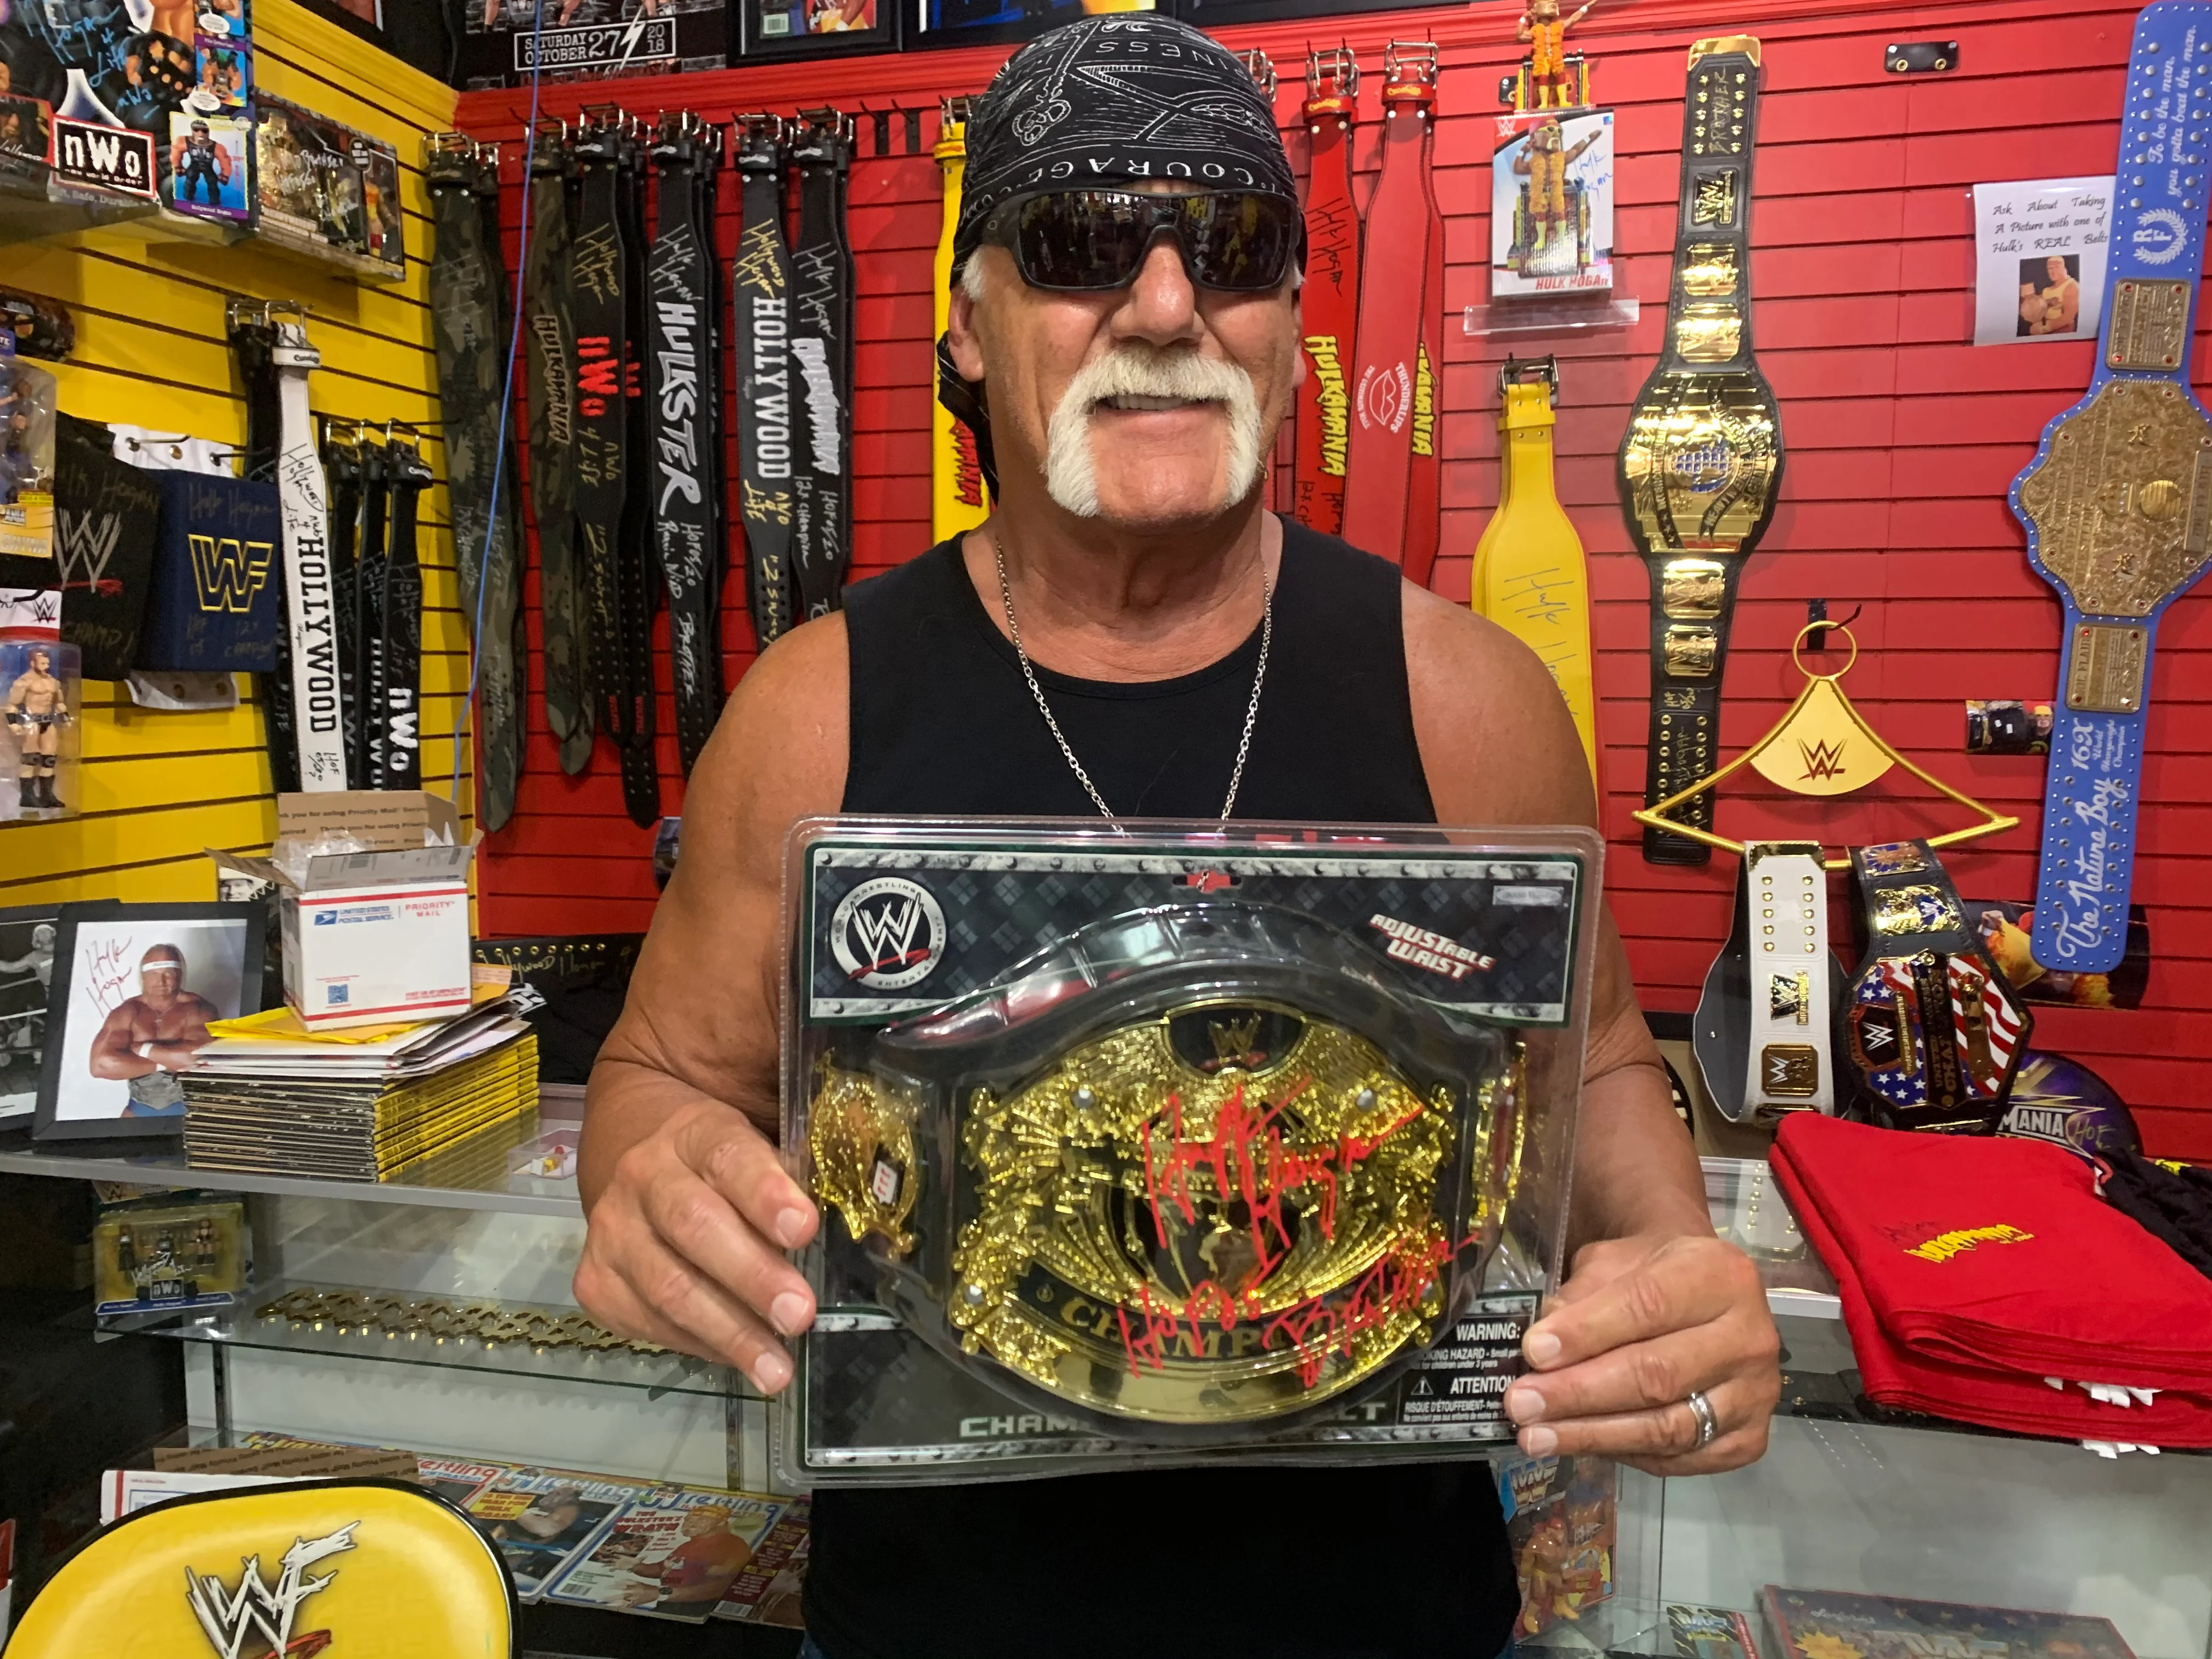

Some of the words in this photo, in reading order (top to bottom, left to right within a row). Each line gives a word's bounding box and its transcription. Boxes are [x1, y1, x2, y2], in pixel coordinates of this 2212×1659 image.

[588, 30, 621, 58] 27
[647, 24, 665, 38] 20
[648, 38, 665, 53] 18
[2174, 66, 2191, 89] the
[2154, 95, 2170, 119] the
[2171, 92, 2188, 124] beat
[2152, 122, 2167, 140] be
[2170, 127, 2187, 165] gotta
[64, 131, 141, 177] nWo
[2147, 143, 2165, 164] To
[2168, 168, 2183, 198] you
[1993, 202, 2013, 215] Ask
[2027, 199, 2058, 212] About
[2072, 194, 2106, 210] Taking
[1995, 223, 2005, 234] A
[2010, 221, 2044, 233] Picture
[2048, 215, 2069, 228] with
[2074, 217, 2090, 226] one
[2095, 212, 2107, 226] of
[1993, 239, 2023, 253] Hulk's
[2034, 236, 2071, 250] REAL
[2084, 231, 2109, 245] Belts
[1536, 275, 1565, 290] HULK
[577, 336, 619, 417] nWo
[753, 297, 791, 479] HOLLYWOOD
[656, 301, 702, 516] HULKSTER
[1304, 335, 1350, 476] HULKAMANIA
[1395, 362, 1410, 434] THUNDERLIPS
[297, 535, 337, 733] HOLLYWOOD
[388, 687, 418, 772] nWo
[2070, 718, 2094, 771] 16X
[2074, 777, 2129, 826] Boy
[2068, 824, 2109, 909] Nature
[836, 905, 849, 944] WORLD
[853, 882, 917, 899] WRESTLING
[2055, 900, 2102, 958] The
[86, 936, 132, 978] Hulk
[1370, 913, 1496, 972] ADJUSTABLE
[1386, 938, 1475, 981] WAIST
[86, 966, 132, 1019] Hogan
[1457, 1322, 1521, 1341] WARNING:
[1451, 1347, 1486, 1360] HAZARD
[1405, 1401, 1430, 1413] RISQUE
[612, 1522, 680, 1533] WRATH
